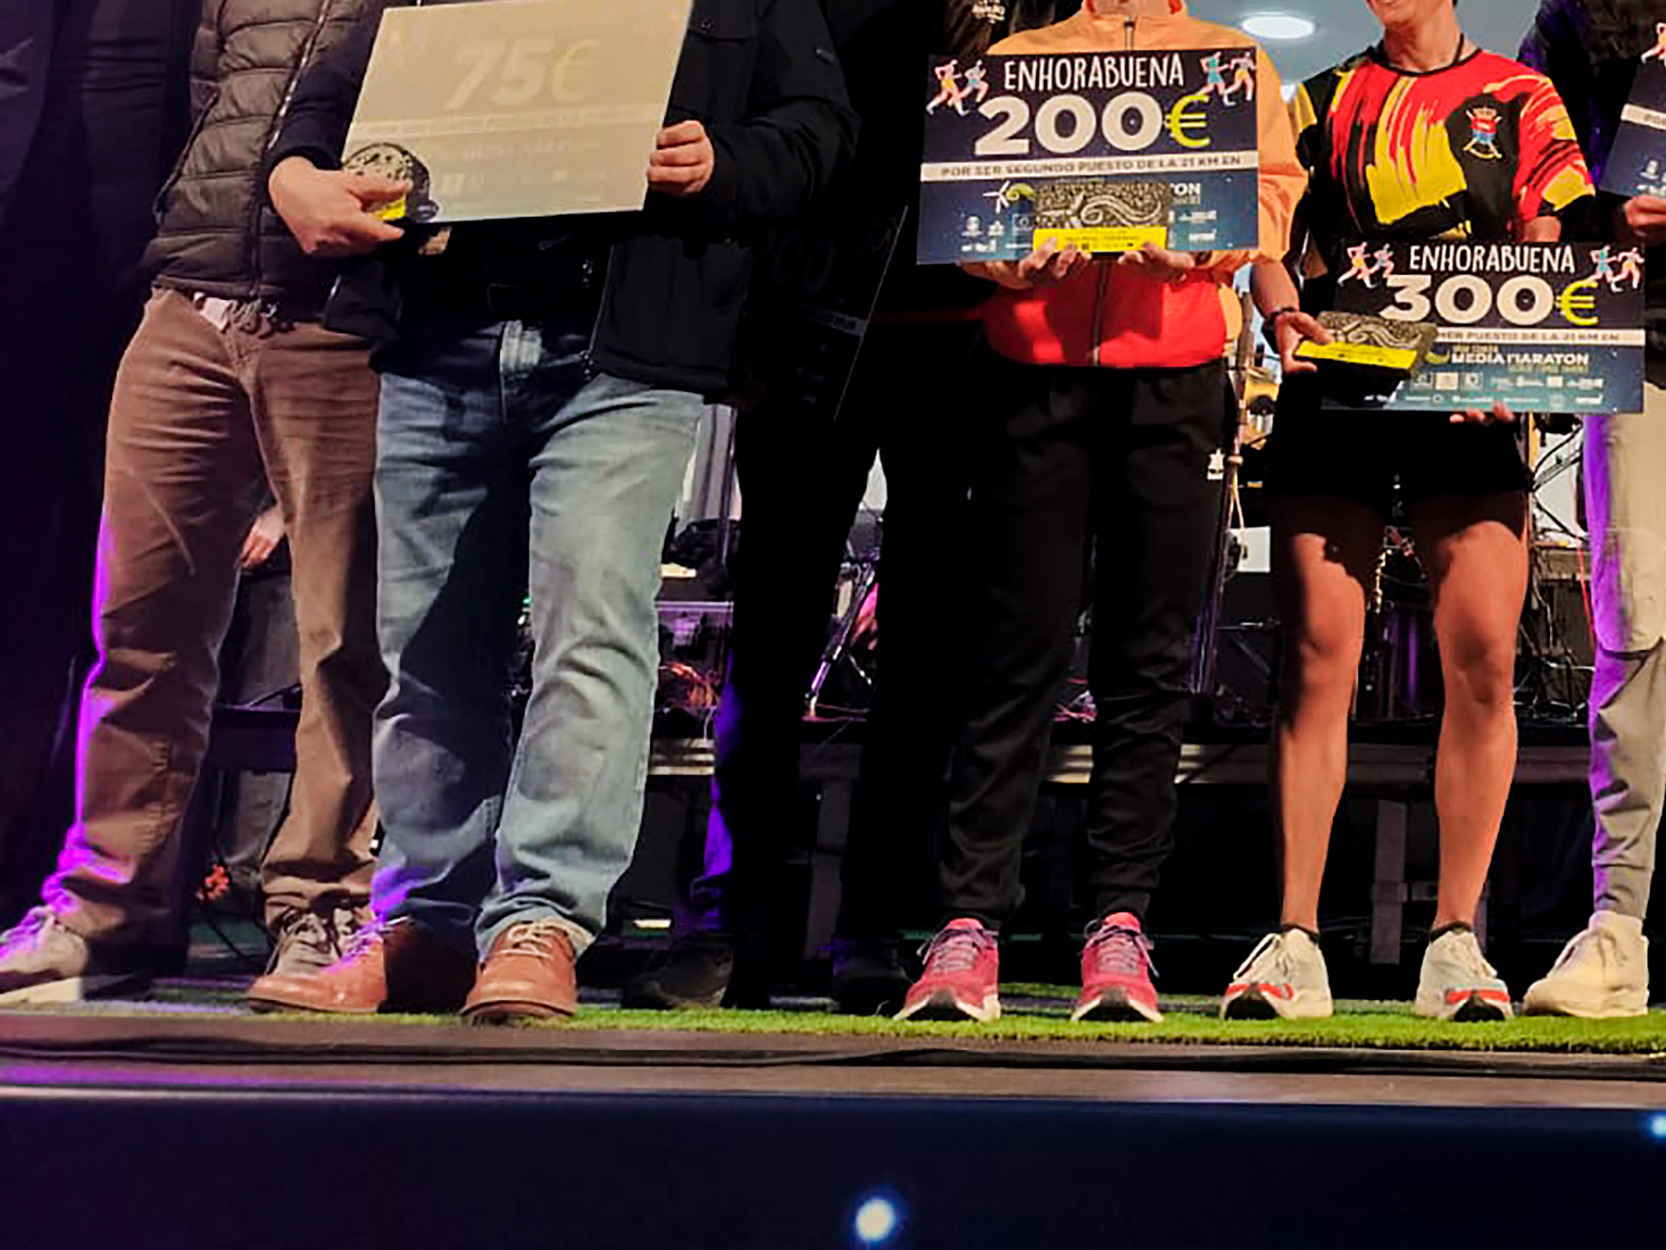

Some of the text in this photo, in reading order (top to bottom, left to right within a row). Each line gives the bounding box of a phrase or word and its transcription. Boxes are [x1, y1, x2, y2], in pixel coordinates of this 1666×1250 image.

[1004, 53, 1185, 92] ENHORABUENA
[974, 91, 1211, 156] 200€
[941, 166, 969, 177] POR
[975, 165, 1001, 175] SER
[1005, 162, 1074, 174] SEGUNDO
[1077, 159, 1132, 171] PUESTO
[1136, 159, 1153, 169] DE
[1157, 158, 1177, 168] LA
[1197, 156, 1218, 166] KM
[1221, 155, 1241, 165] EN
[1409, 244, 1576, 274] ENHORABUENA
[1379, 274, 1600, 328] 300€
[1600, 334, 1619, 342] EN
[1451, 352, 1589, 366] MEDIA MARATON
